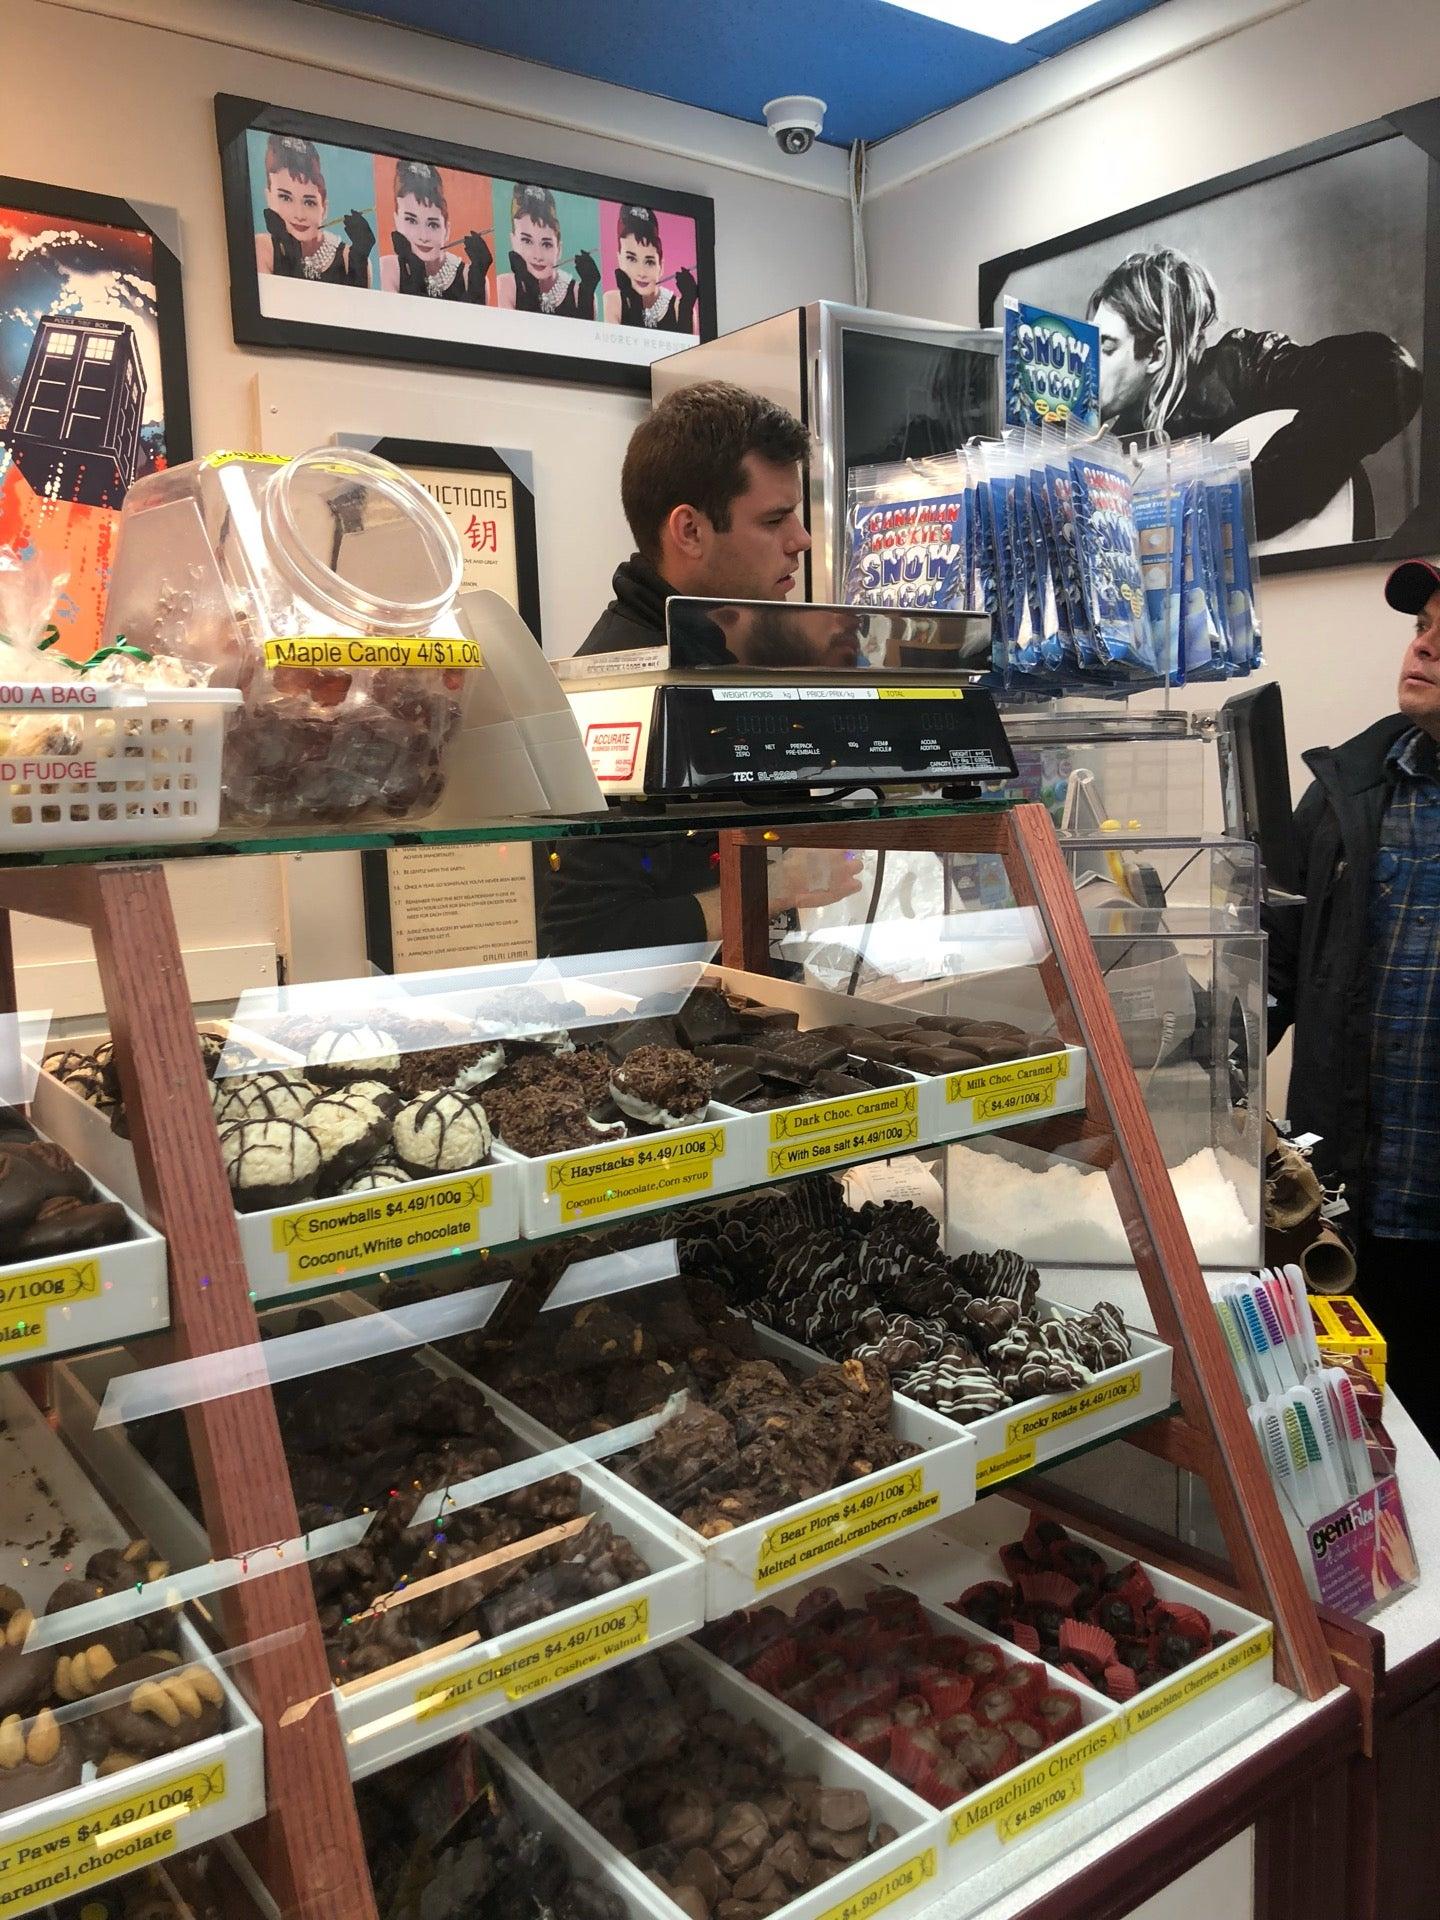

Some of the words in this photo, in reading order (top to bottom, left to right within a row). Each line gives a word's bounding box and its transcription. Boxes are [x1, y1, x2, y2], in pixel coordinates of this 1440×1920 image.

[1018, 323, 1090, 377] SNOW
[869, 503, 961, 533] CANADIAN
[872, 523, 953, 553] ROCKIES
[862, 543, 961, 589] SNOW
[275, 642, 342, 666] Maple
[348, 642, 411, 666] Candy
[418, 642, 480, 664] 4/$1.00
[31, 686, 45, 704] A
[52, 686, 96, 704] BAG
[594, 734, 631, 744] ACCURATE
[2, 764, 16, 780] D
[23, 762, 96, 780] FUDGE
[733, 772, 754, 782] TEC
[967, 1078, 986, 1090] Milk
[989, 1074, 1014, 1086] Choc.
[1018, 1064, 1053, 1079] Caramel
[794, 1114, 820, 1128] Dark
[824, 1110, 853, 1122] Choc.
[857, 1097, 898, 1114] Caramel
[992, 1092, 1040, 1111] $4.49/100g
[570, 1156, 634, 1180] Haystacks
[638, 1140, 706, 1166] $4.49/100g
[788, 1148, 810, 1162] With
[812, 1146, 830, 1157] Sea
[834, 1140, 851, 1153] salt
[852, 1127, 903, 1147] $4.49/100g
[683, 1171, 709, 1185] syrup
[308, 1208, 382, 1234] Snowballs
[386, 1190, 462, 1217] $4.49/100g
[408, 1221, 471, 1245] chocolate
[1022, 1415, 1049, 1434] Rocky
[1052, 1404, 1078, 1422] Roads
[1080, 1384, 1128, 1411] $4.49/100g
[780, 1526, 807, 1544] Bear
[810, 1512, 840, 1533] Plops
[842, 1484, 905, 1520] $4.49/100g
[758, 1553, 797, 1580] Melted
[478, 1652, 540, 1686] Clusters
[544, 1616, 626, 1658] $4.49/100g
[603, 1633, 642, 1656] Walnut
[1137, 1690, 1183, 1723] Marachino
[1184, 1668, 1220, 1694] Cherries
[966, 1772, 1046, 1828] Marachino
[1048, 1733, 1107, 1777] Cherries
[1015, 1790, 1066, 1827] $4.99/100g
[18, 1835, 71, 1864] Paws
[78, 1786, 194, 1842] $4.49/100g
[0, 1828, 173, 1905] aramel,chocolate
